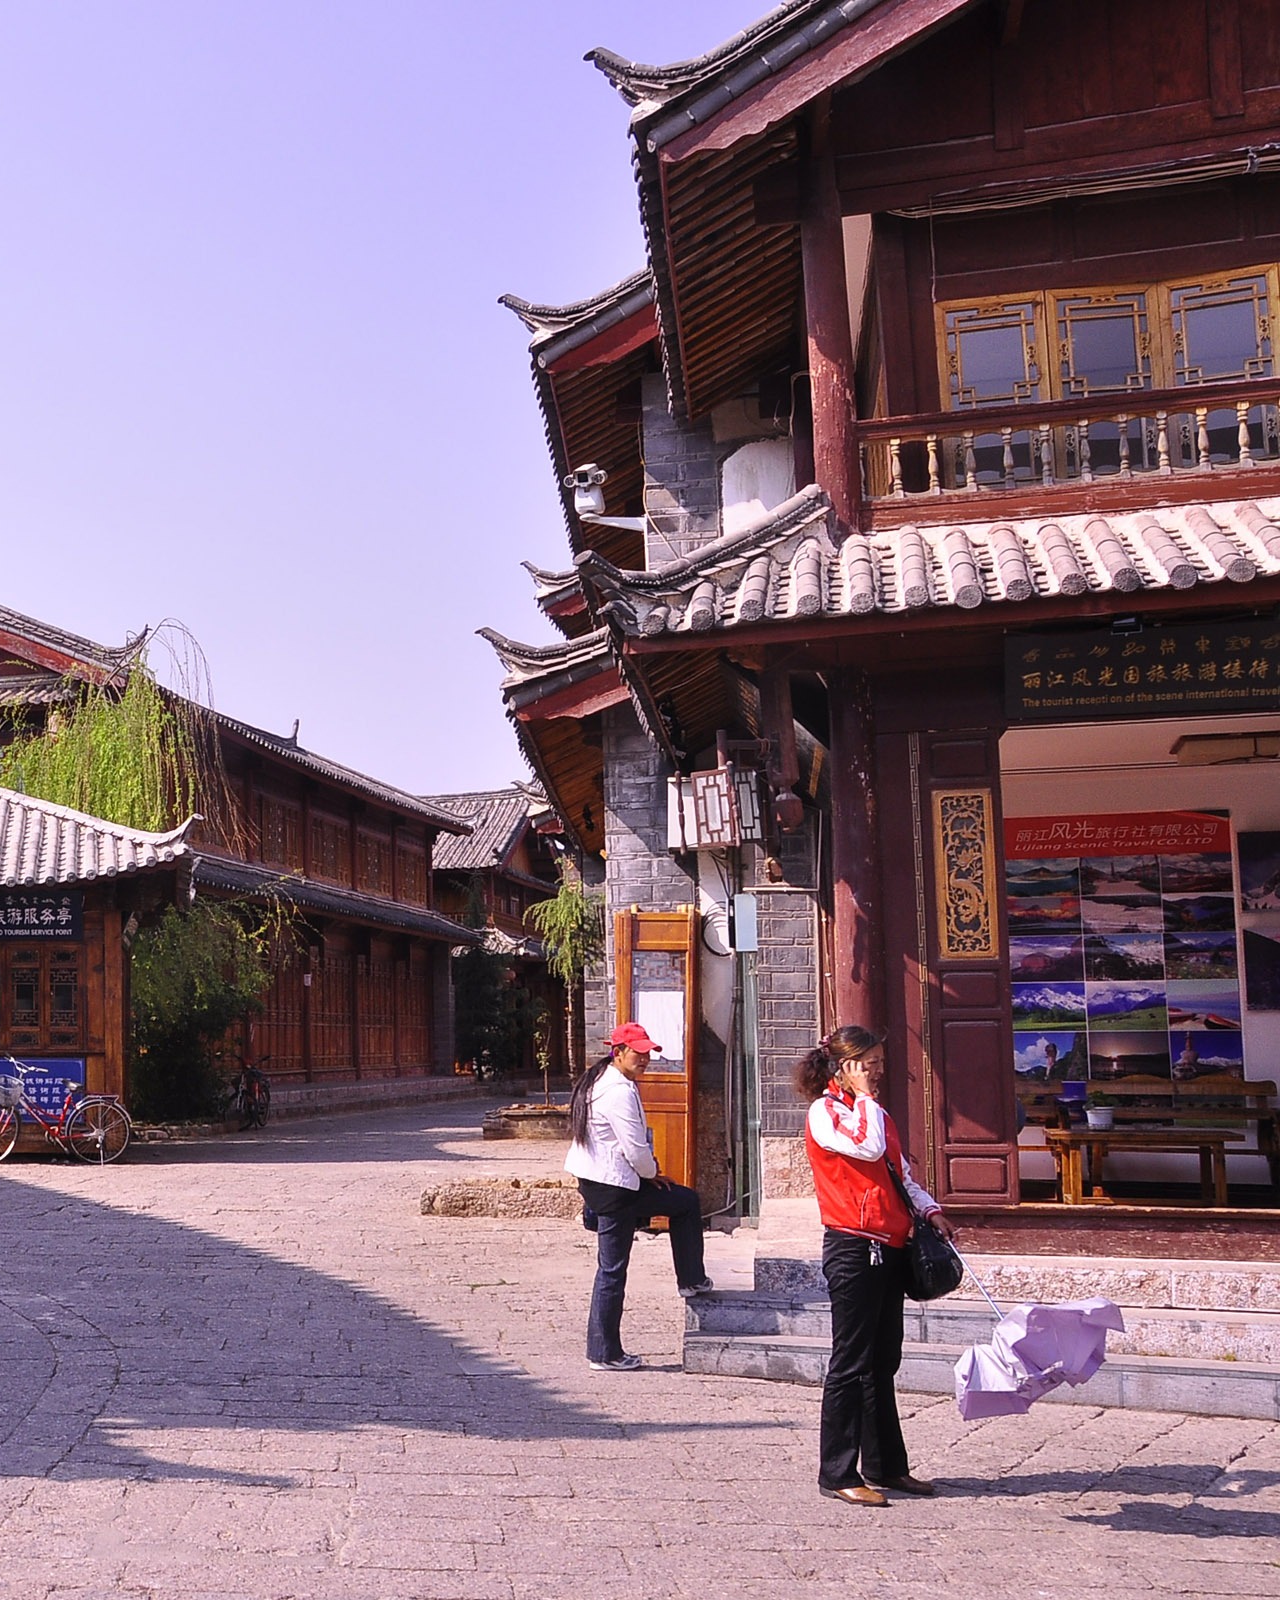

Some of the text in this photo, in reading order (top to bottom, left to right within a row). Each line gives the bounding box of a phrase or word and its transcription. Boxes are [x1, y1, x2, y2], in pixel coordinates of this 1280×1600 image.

[1022, 657, 1280, 689] 丽江风光国旅旅游接待
[1022, 698, 1040, 707] The
[1042, 696, 1073, 706] tourist
[1125, 693, 1134, 702] of
[1137, 692, 1152, 701] the
[1155, 692, 1183, 700] scene
[1186, 688, 1249, 699] international
[1015, 820, 1218, 842] 丽江风光旅行社有限公司
[1015, 842, 1061, 851] Lijiang
[1064, 840, 1109, 849] Scenic
[1112, 839, 1155, 847] Travel
